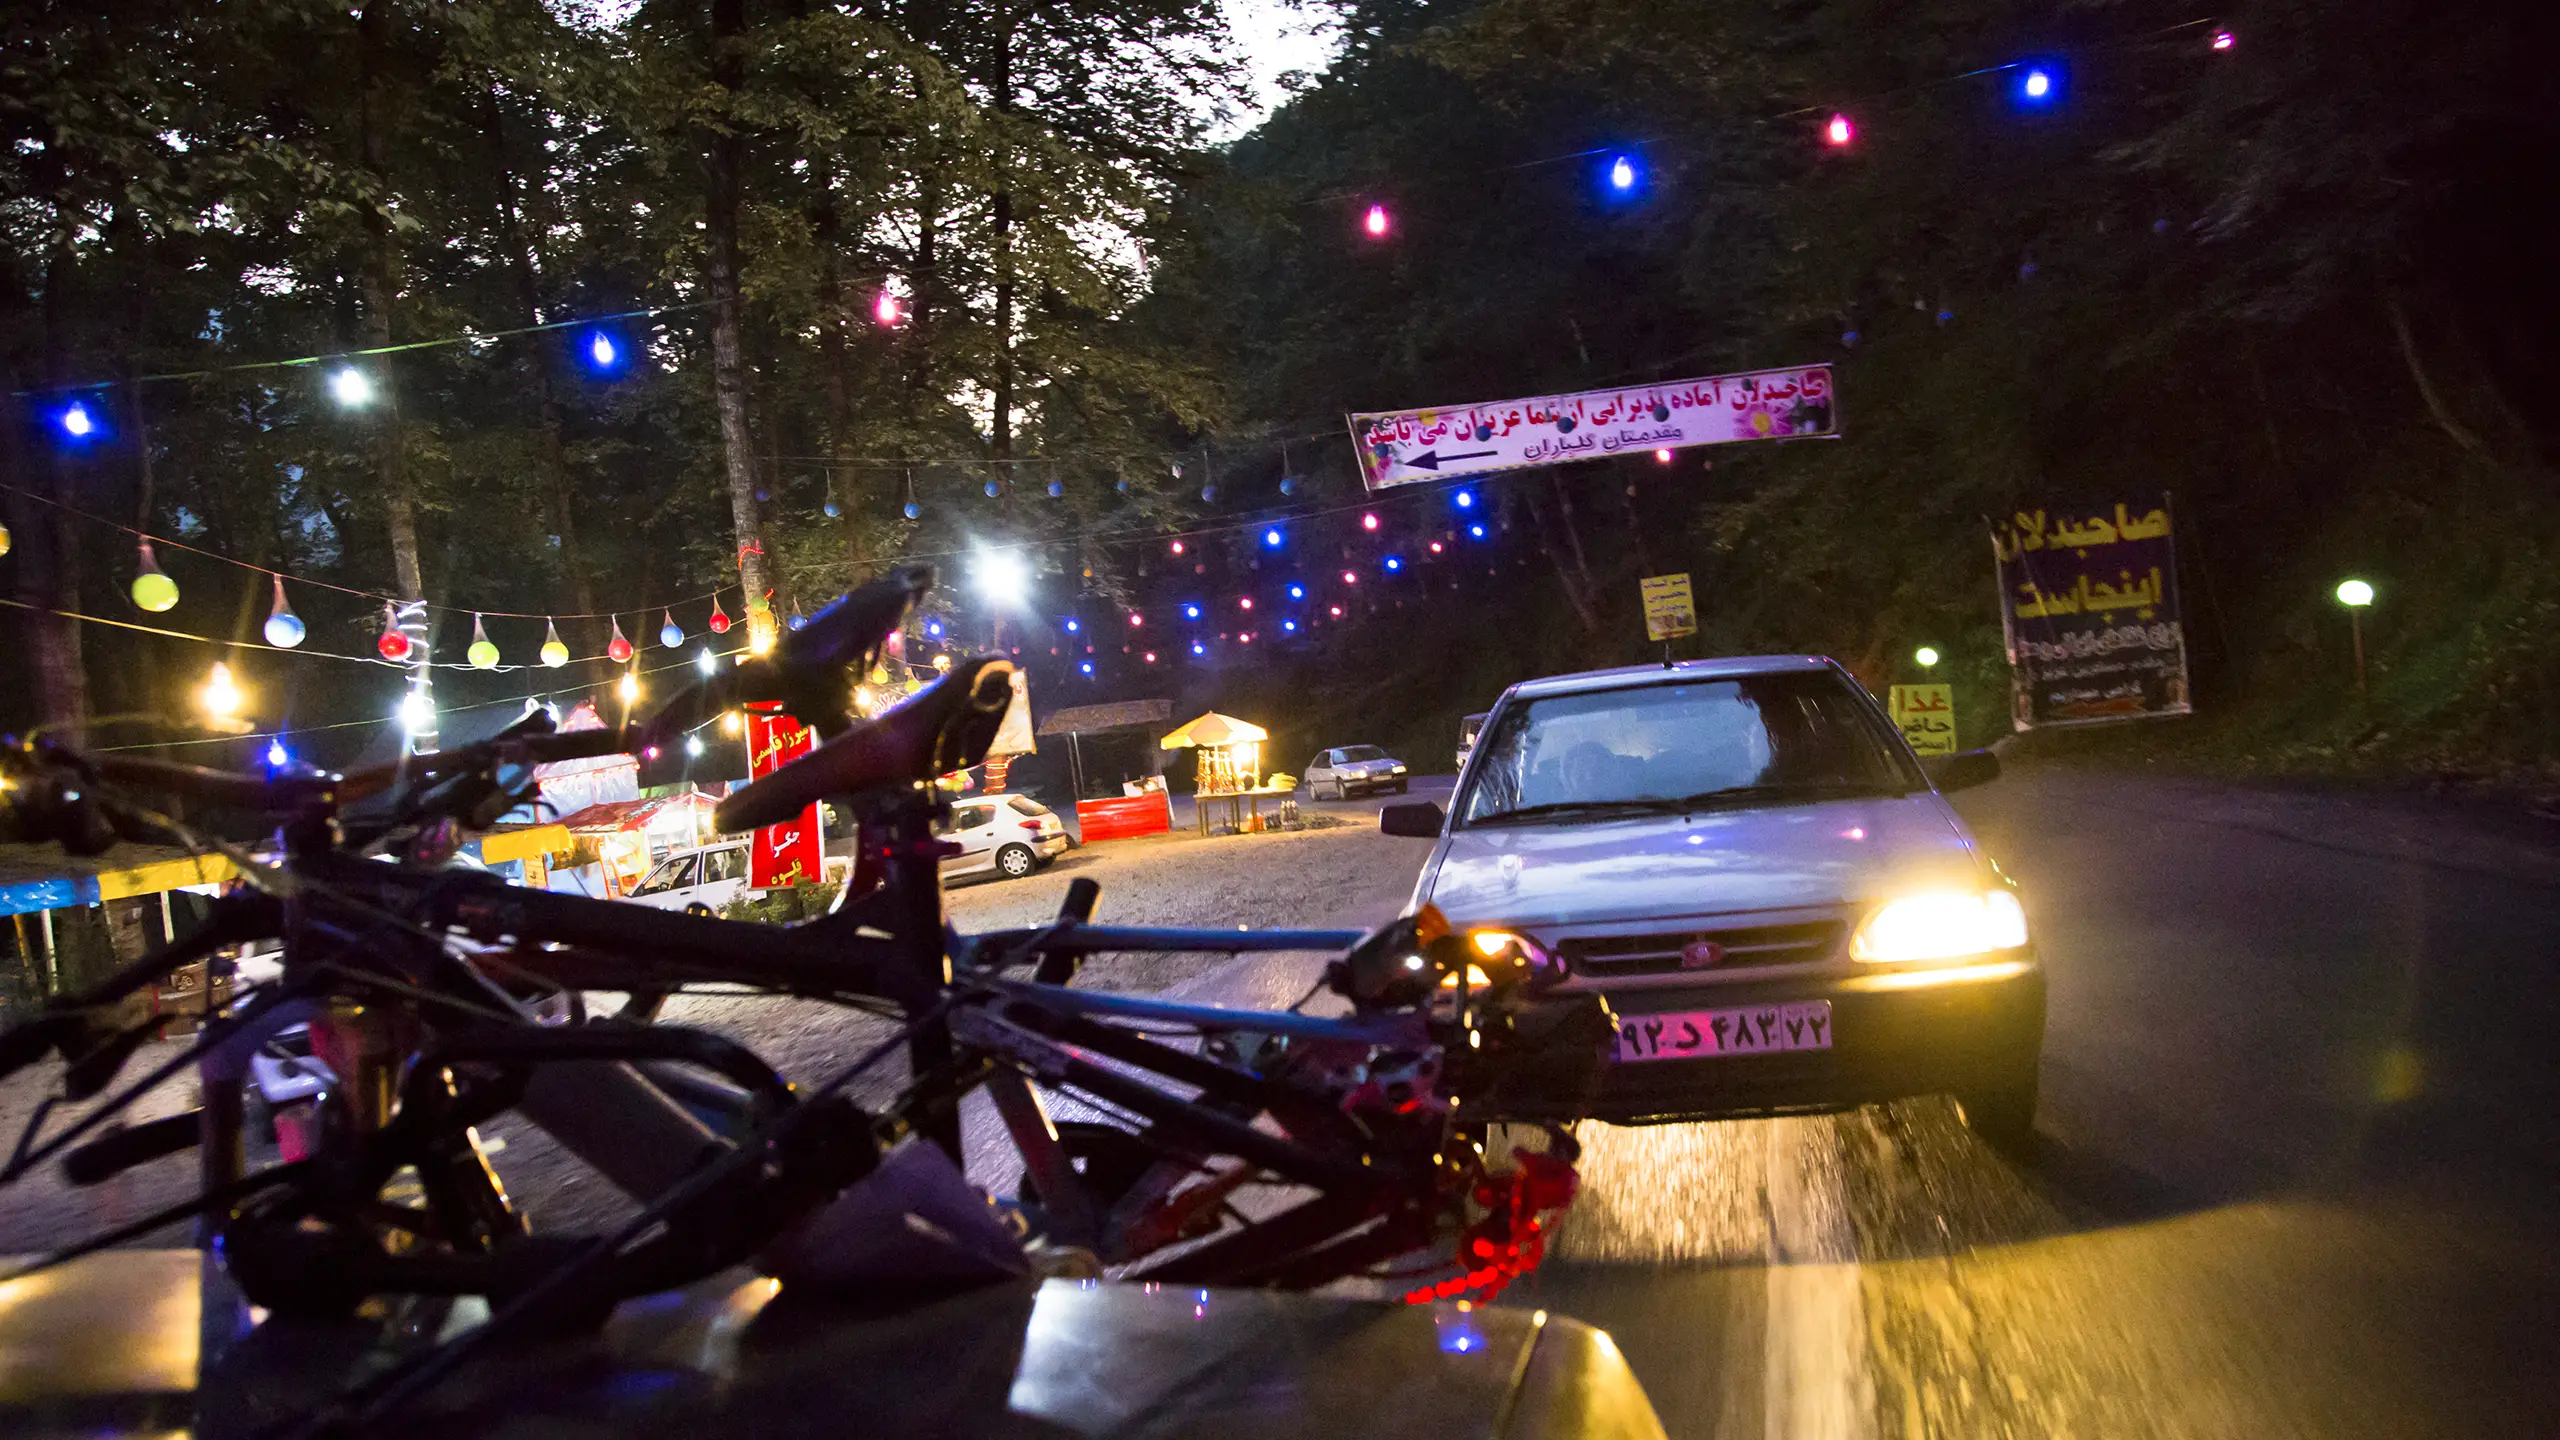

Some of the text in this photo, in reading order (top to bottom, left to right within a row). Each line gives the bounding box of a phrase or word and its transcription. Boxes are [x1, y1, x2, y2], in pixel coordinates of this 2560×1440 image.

[1671, 380, 1721, 409] آماده
[1526, 401, 1561, 425] شما
[1565, 399, 1584, 429] از
[1368, 417, 1412, 447] باشد
[1418, 421, 1448, 445] می
[1524, 424, 1684, 461] مقدمتان گلباران
[1996, 503, 2170, 561] صاحبدلان
[2014, 567, 2162, 624] اینجاست
[1899, 688, 1950, 712] غذا
[752, 726, 809, 768] میرزا قاسمی
[1910, 736, 1953, 752] است
[773, 831, 801, 858] جگر
[771, 857, 803, 885] قلوه
